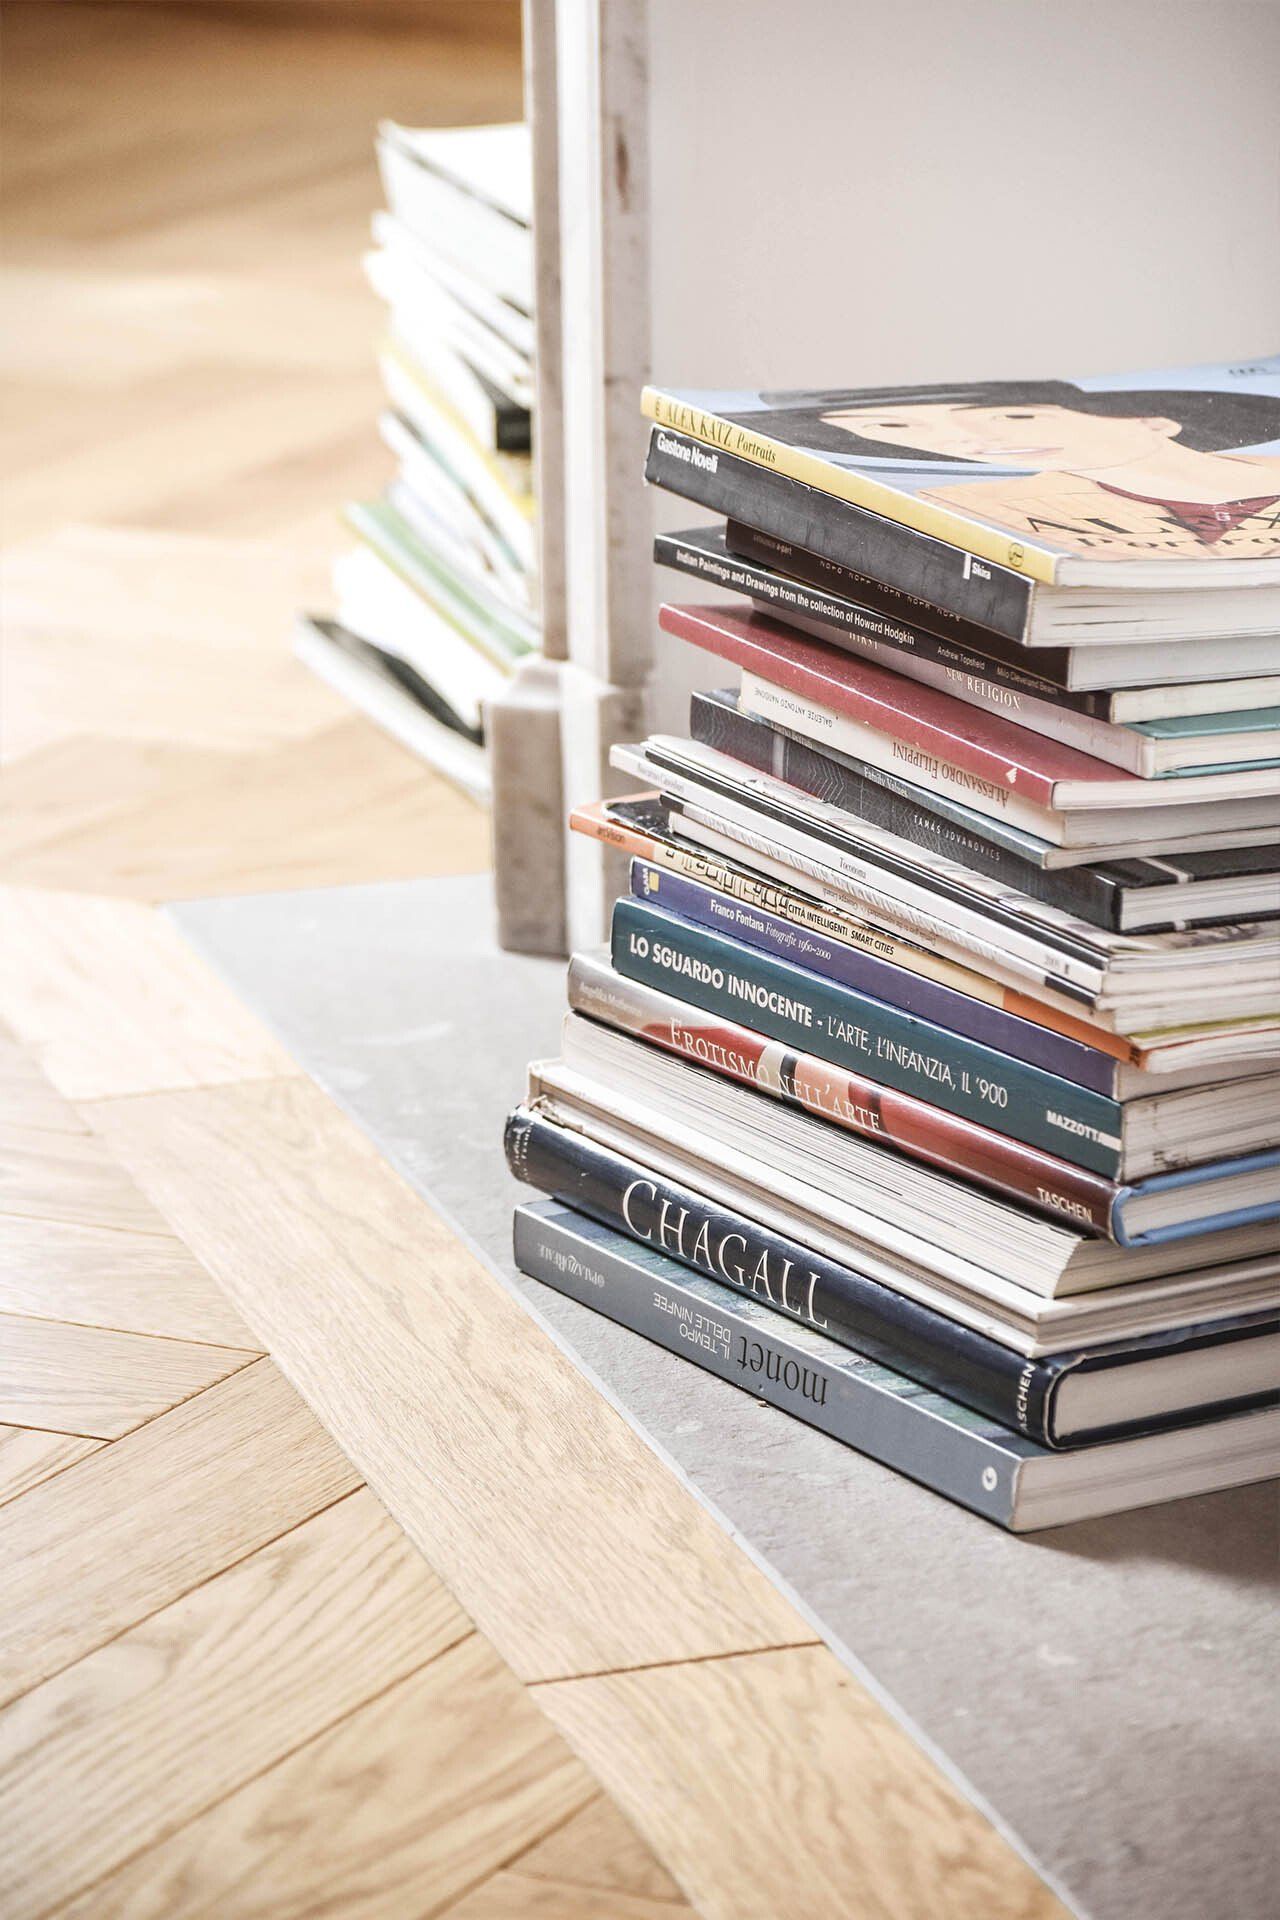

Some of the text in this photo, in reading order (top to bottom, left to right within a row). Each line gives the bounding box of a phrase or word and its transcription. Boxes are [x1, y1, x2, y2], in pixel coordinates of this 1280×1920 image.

[657, 432, 719, 473] Gastone Novelli
[667, 402, 695, 432] ALEX
[700, 415, 732, 446] KATZ
[736, 431, 776, 463] Portraits
[676, 549, 915, 645] Indian Paintings and Drawings from the collection of Howard Hodgkin
[937, 646, 958, 660] Andrew
[967, 676, 1021, 710] RELIGION
[863, 766, 886, 788] Family
[892, 741, 1010, 808] ALESSANDRO FILIPPINI
[710, 899, 734, 920] Franco
[735, 909, 765, 933] Fontana
[765, 922, 796, 947] Fotografie
[807, 912, 848, 937] INTELLIGENTI
[850, 930, 874, 947] SMART
[874, 940, 895, 956] CITIES
[630, 933, 649, 959] LO
[652, 943, 724, 990] SGUARDO
[728, 973, 813, 1028] INNOCENTE
[827, 1015, 872, 1056] L'ARTE,
[877, 1035, 957, 1092] L'INFANZIA,
[962, 1071, 972, 1095] IL
[975, 1079, 1008, 1109] '900
[670, 1016, 880, 1131] EROTISMO NELL'ARTE
[1047, 1110, 1108, 1146] MAZZOTTA
[1037, 1186, 1093, 1224] TASCHEN
[622, 1179, 829, 1329] CHAGALL
[653, 1292, 731, 1343] DELLE NINFEE
[679, 1323, 731, 1360] IL TEMPO
[737, 1336, 828, 1406] monet
[1017, 1363, 1036, 1433] ASCHEN
